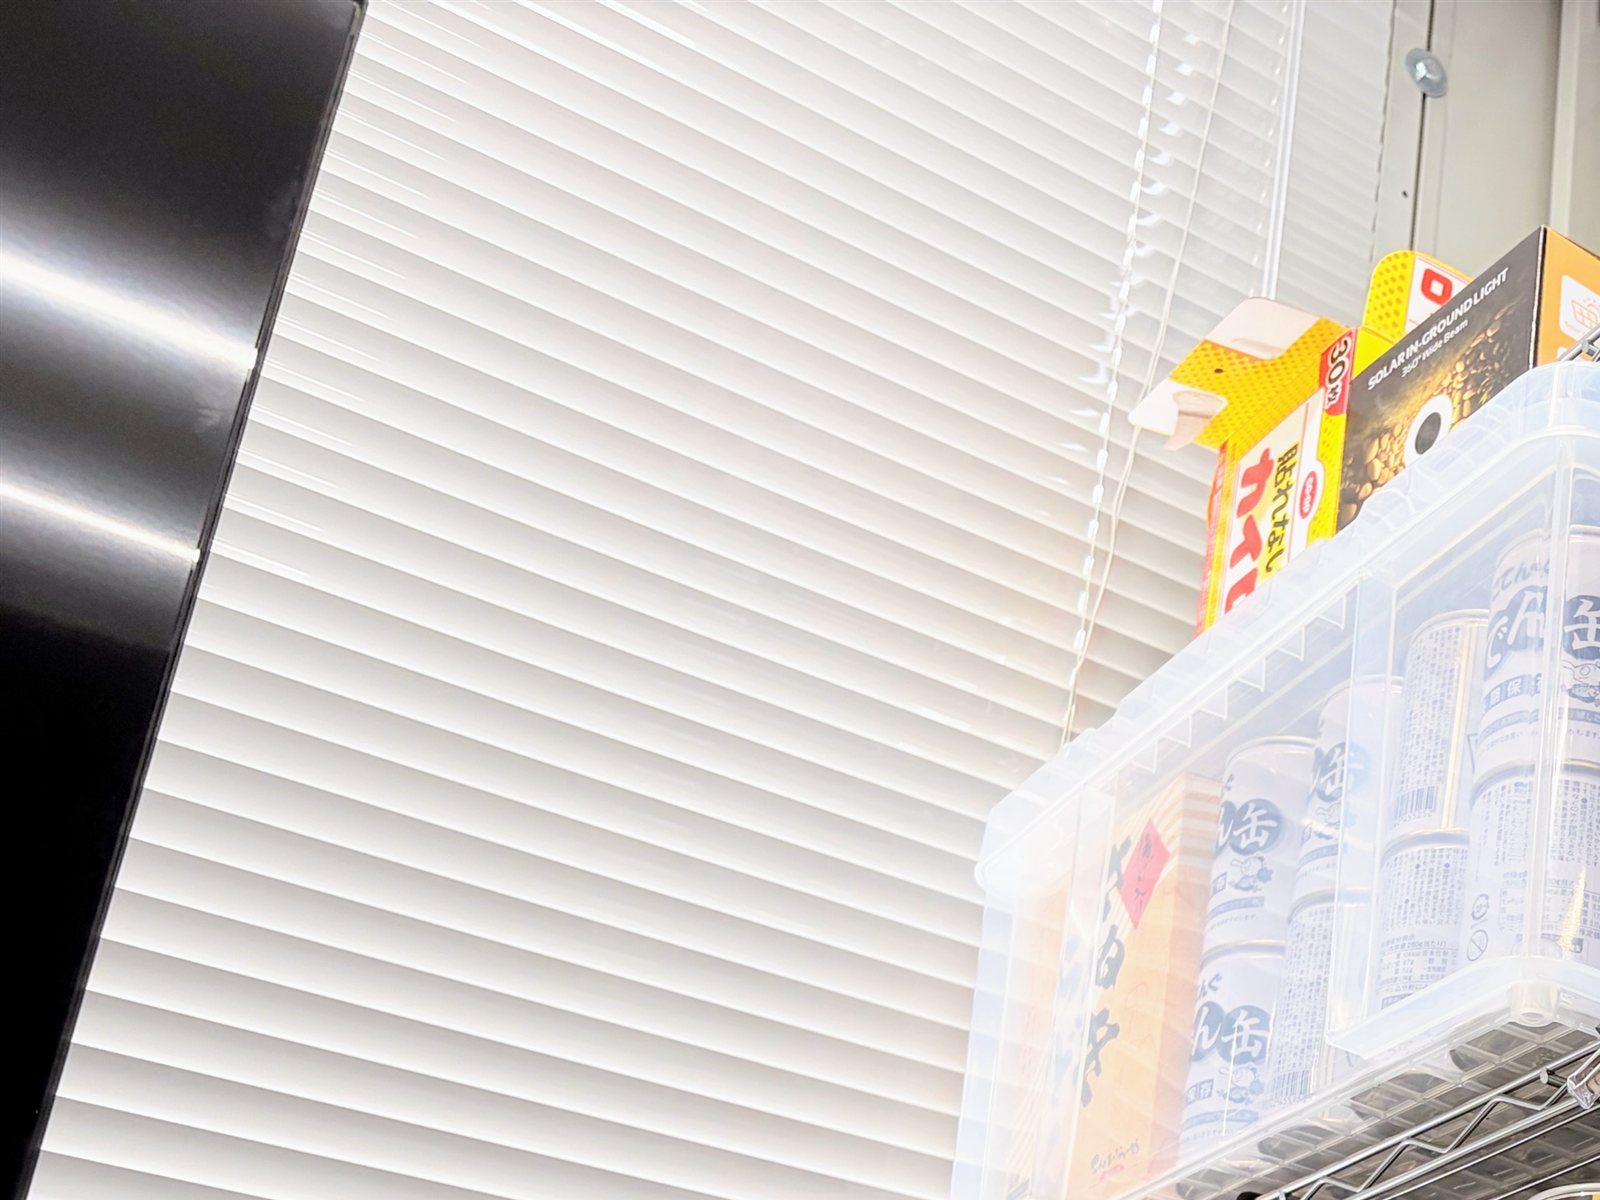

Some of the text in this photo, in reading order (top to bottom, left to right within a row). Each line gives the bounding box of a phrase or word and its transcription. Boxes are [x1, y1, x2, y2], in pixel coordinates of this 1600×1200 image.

[1367, 267, 1509, 390] SOLAR IN-GROUND LIGHT
[1421, 340, 1444, 362] Wide
[1443, 319, 1468, 344] Beam
